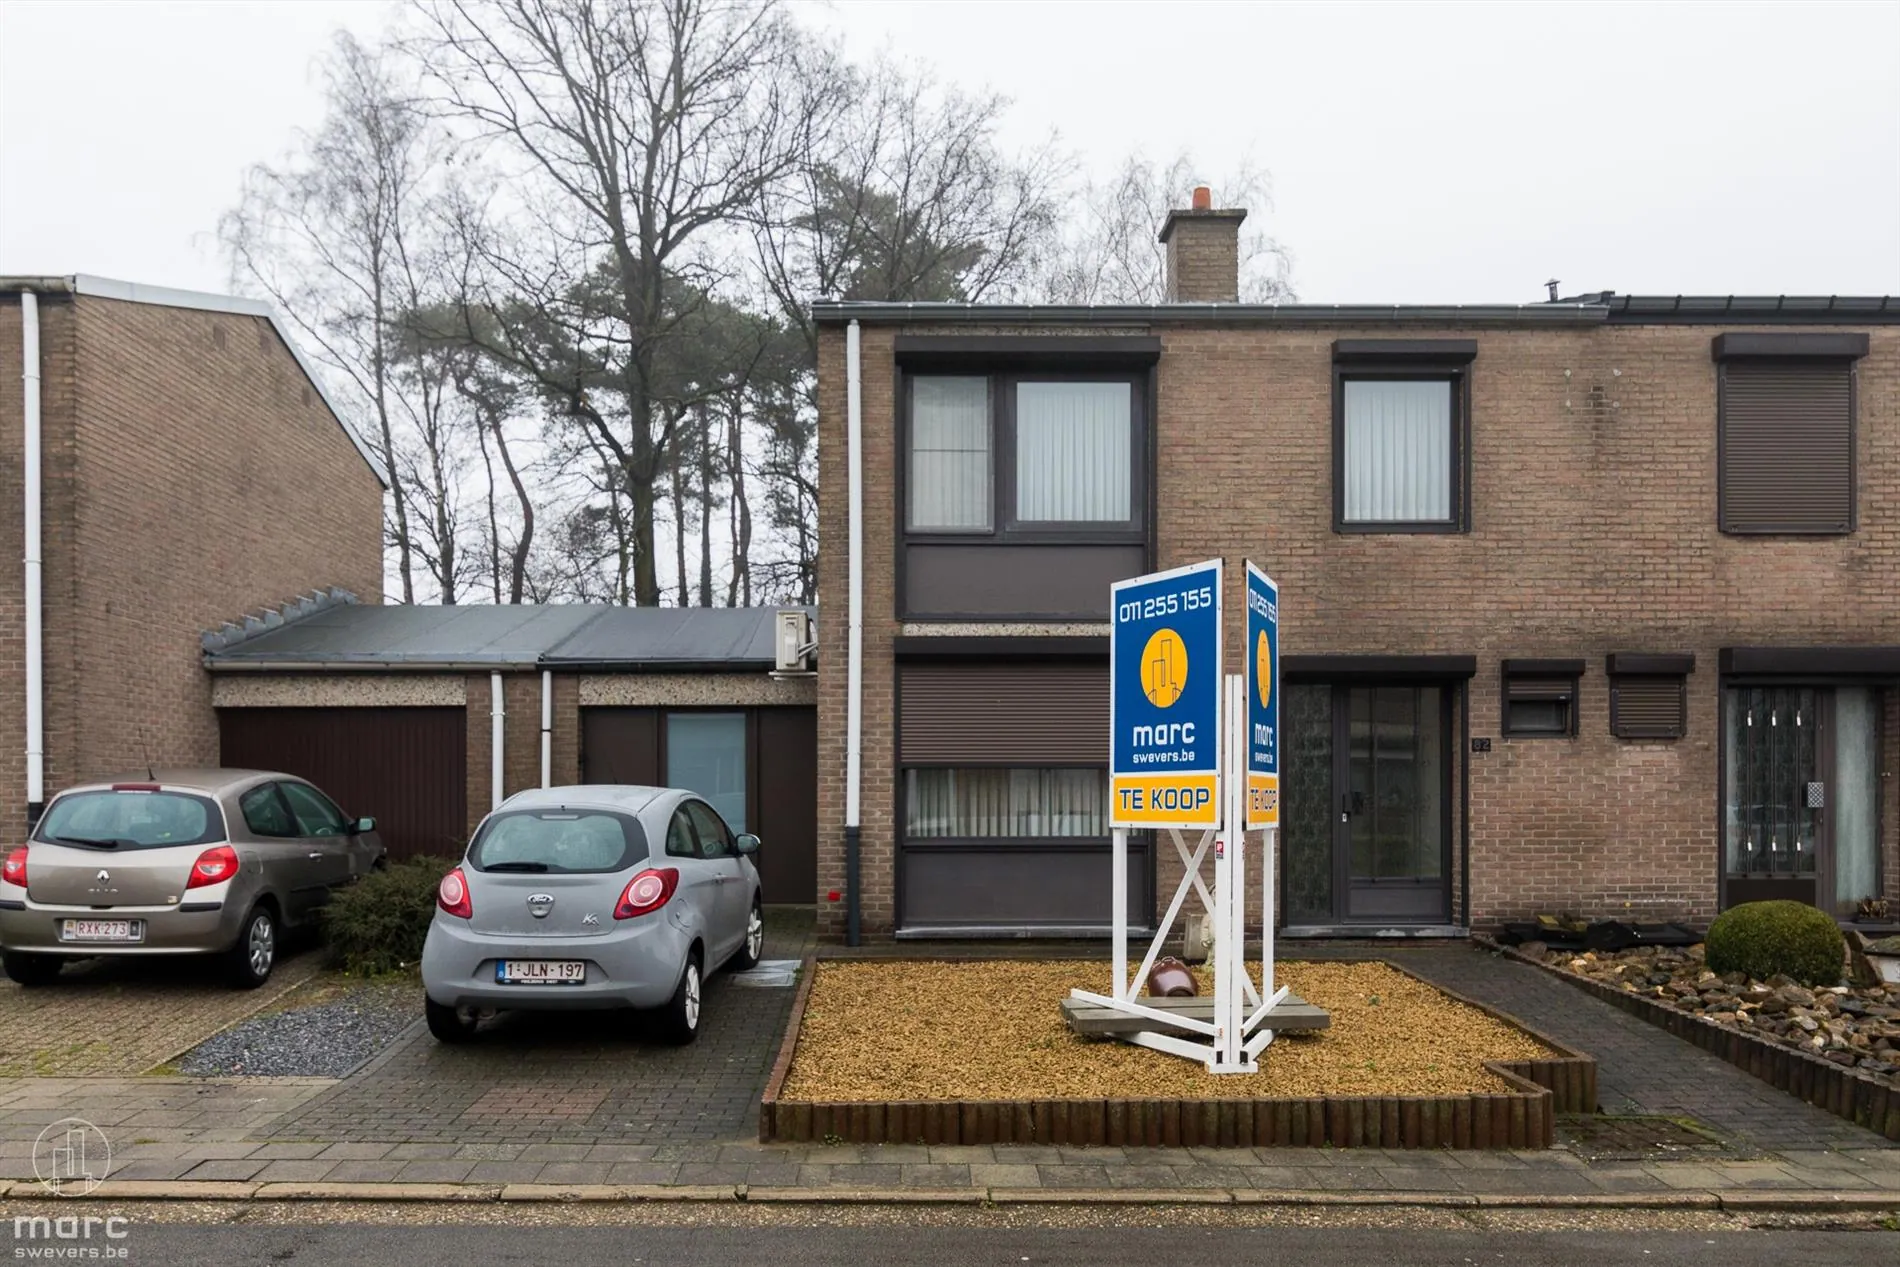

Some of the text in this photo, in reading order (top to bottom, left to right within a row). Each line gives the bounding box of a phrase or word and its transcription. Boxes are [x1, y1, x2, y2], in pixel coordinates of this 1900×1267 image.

[1120, 586, 1211, 623] 011 255 155
[1133, 722, 1195, 747] marc
[1255, 723, 1273, 747] marc
[1132, 748, 1195, 764] swevers.be
[1119, 788, 1209, 810] TE KOOP
[1250, 789, 1259, 810] TE
